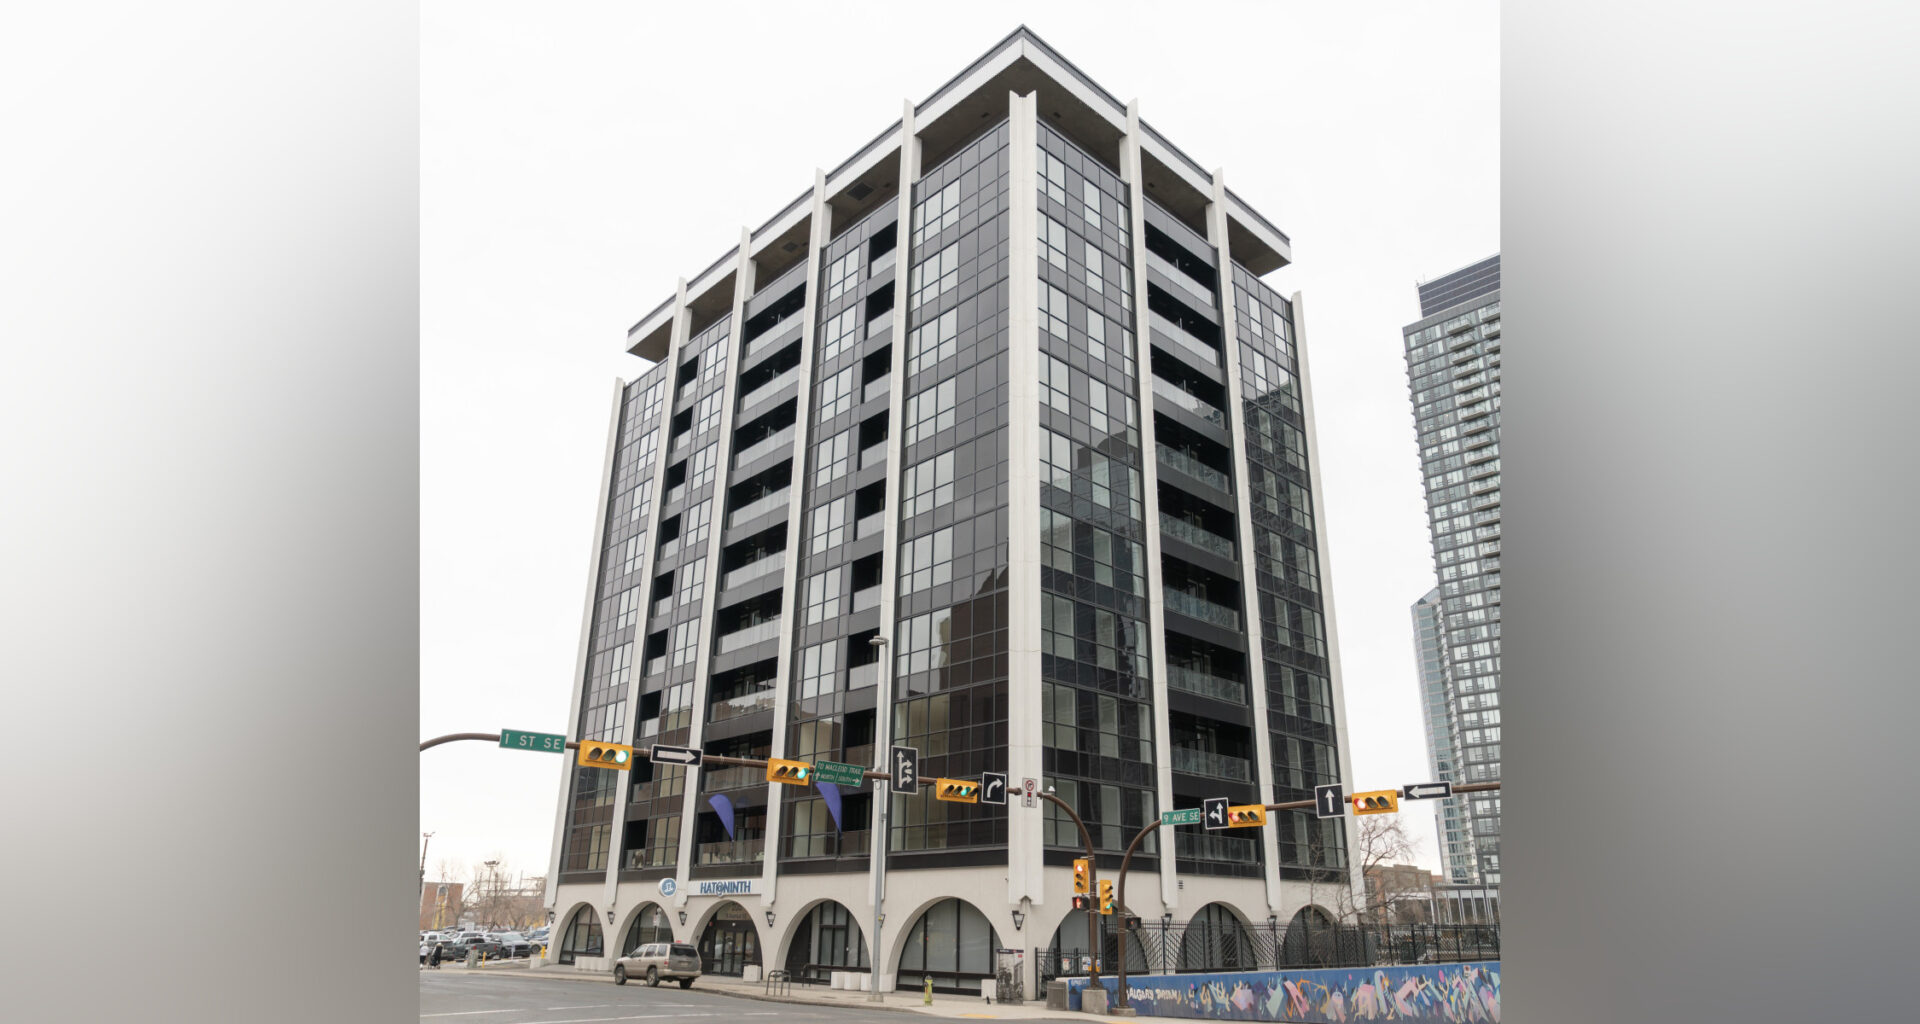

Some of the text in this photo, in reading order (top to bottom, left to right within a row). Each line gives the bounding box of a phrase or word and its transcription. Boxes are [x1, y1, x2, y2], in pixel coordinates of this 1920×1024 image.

[519, 735, 536, 747] ST
[543, 737, 561, 750] SE
[1163, 811, 1199, 823] 9 AVE SE
